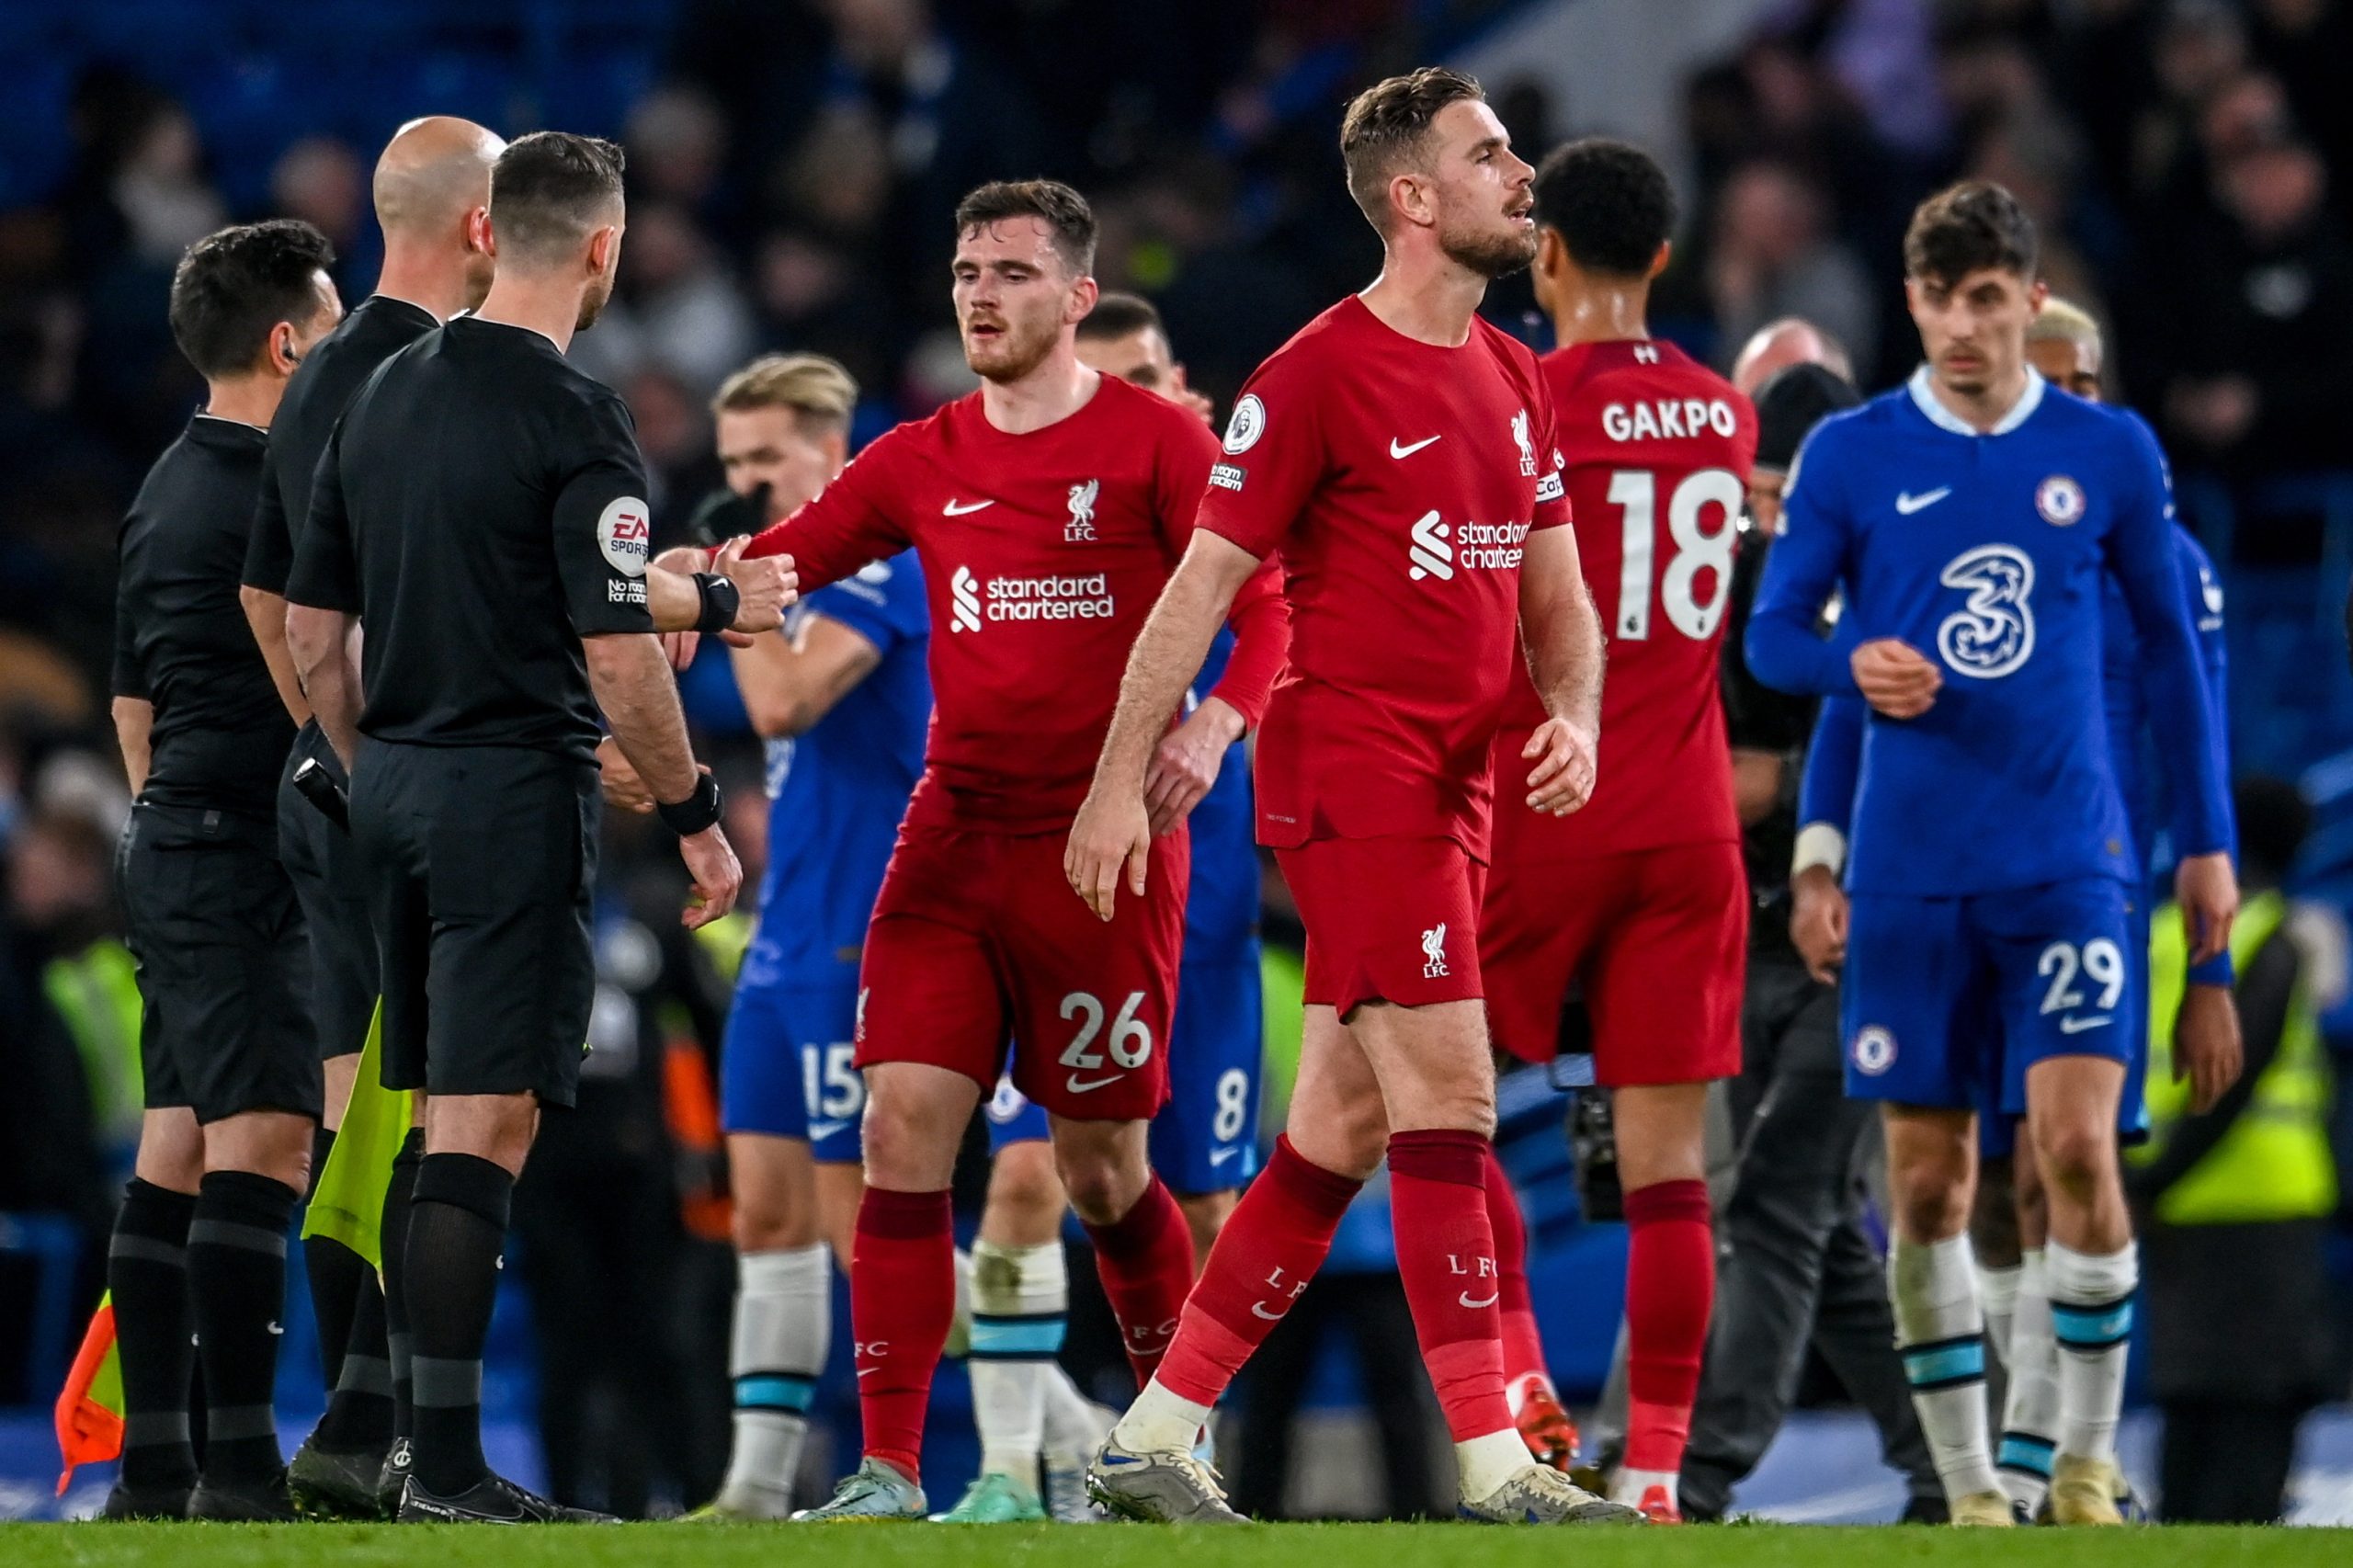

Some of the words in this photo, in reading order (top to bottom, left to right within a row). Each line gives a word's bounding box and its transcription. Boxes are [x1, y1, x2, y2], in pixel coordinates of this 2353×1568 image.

[1602, 399, 1736, 442] GAKPO
[612, 514, 648, 540] EA
[1607, 469, 1745, 641] 18
[608, 578, 627, 592] No
[986, 573, 1106, 598] standard
[986, 595, 1114, 621] chartered
[1937, 543, 2035, 678] 3
[2038, 938, 2124, 1015] 29
[1058, 992, 1152, 1069] 26
[801, 1042, 866, 1119] 15
[1213, 1068, 1249, 1142] 8
